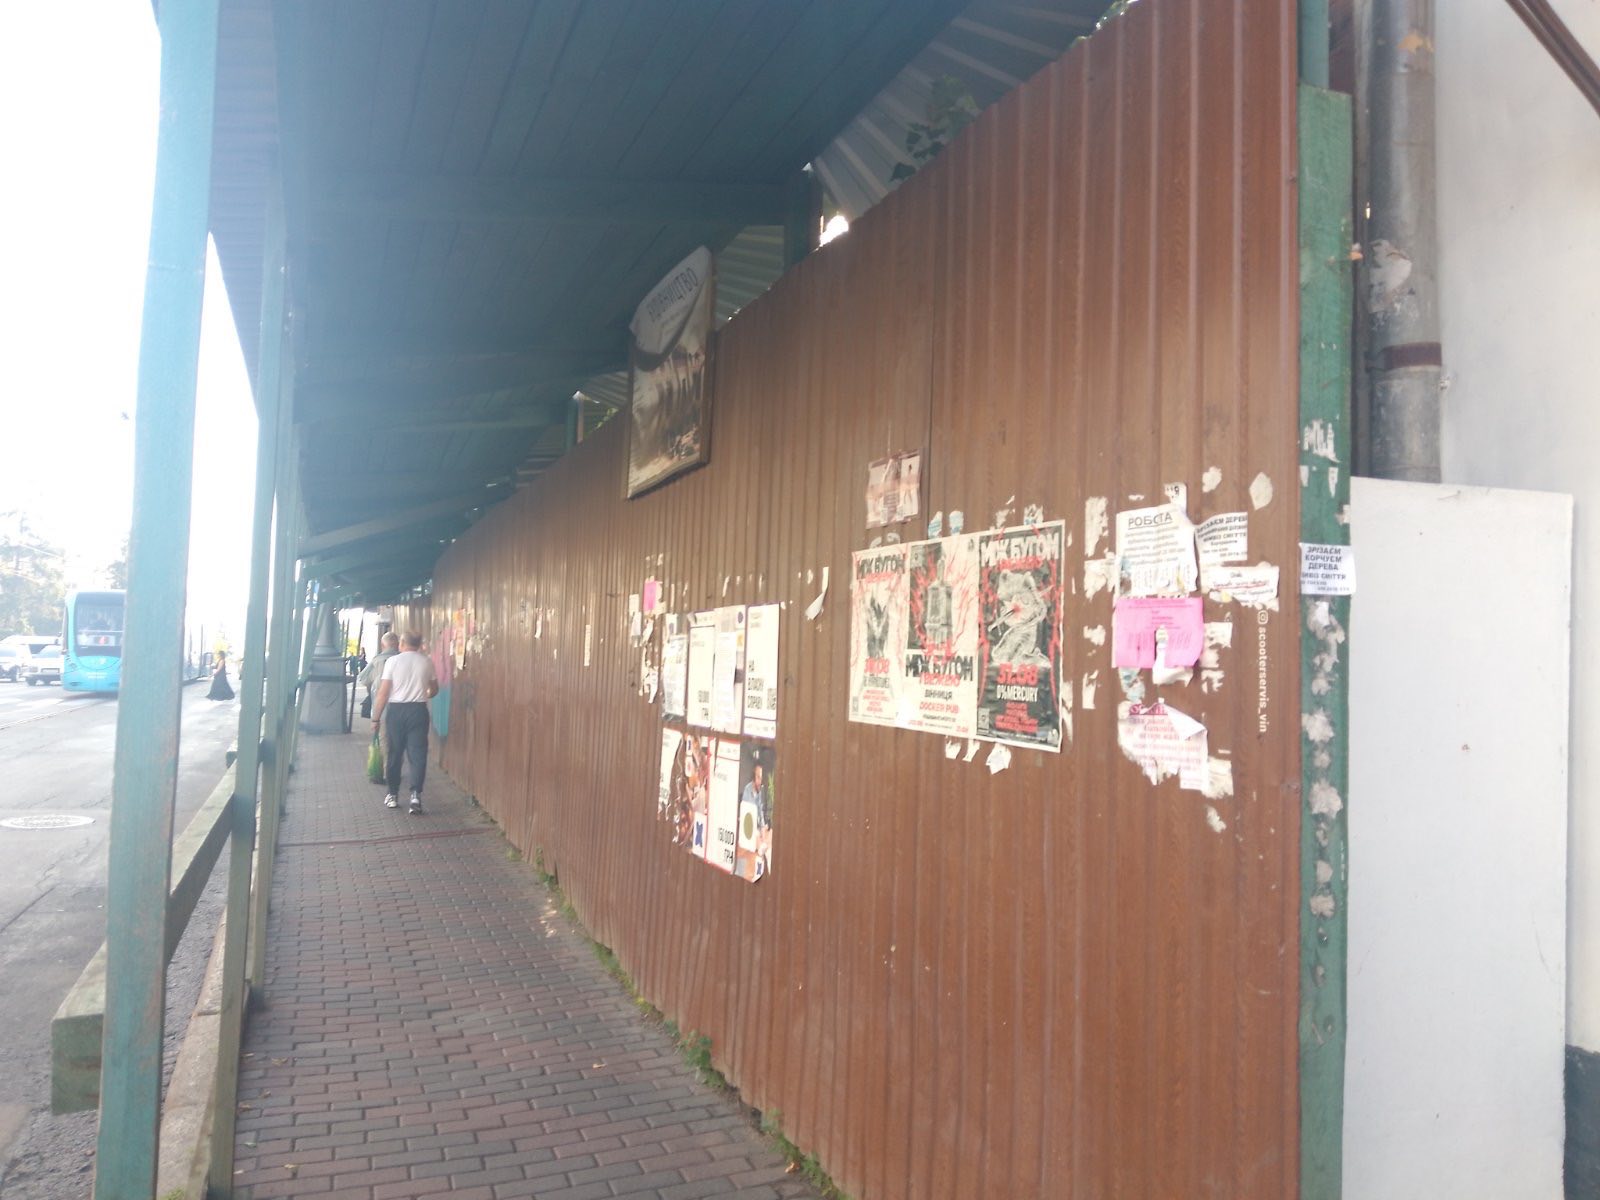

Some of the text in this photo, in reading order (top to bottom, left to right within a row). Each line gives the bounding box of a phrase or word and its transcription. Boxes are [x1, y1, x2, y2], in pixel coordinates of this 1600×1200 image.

[1128, 513, 1173, 528] РОБОТА
[1308, 562, 1339, 571] ДЕРЕВА
[1257, 626, 1270, 733] scooterservis_vin
